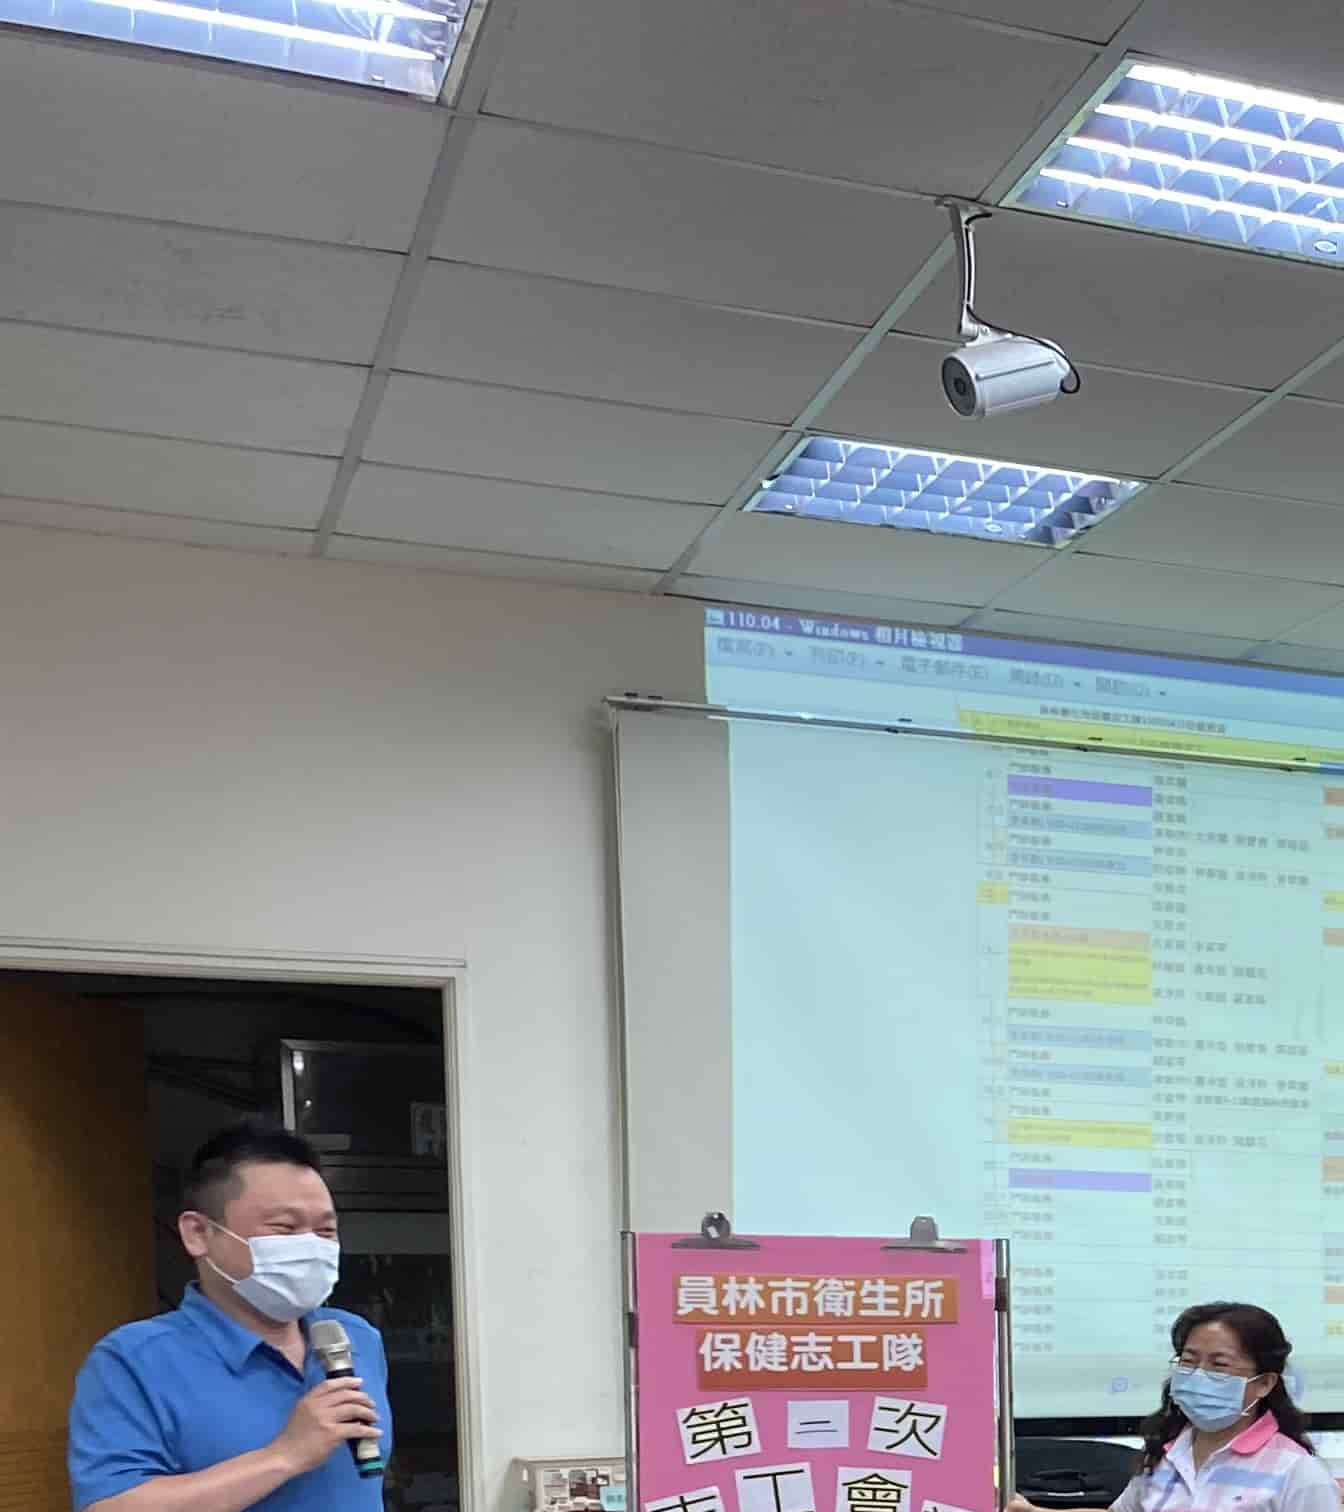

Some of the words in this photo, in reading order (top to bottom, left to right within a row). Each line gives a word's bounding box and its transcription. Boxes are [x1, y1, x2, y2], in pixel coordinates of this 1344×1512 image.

[799, 617, 870, 642] Windows
[675, 1276, 945, 1319] 員林市衛生所
[699, 1333, 925, 1373] 保健志工隊
